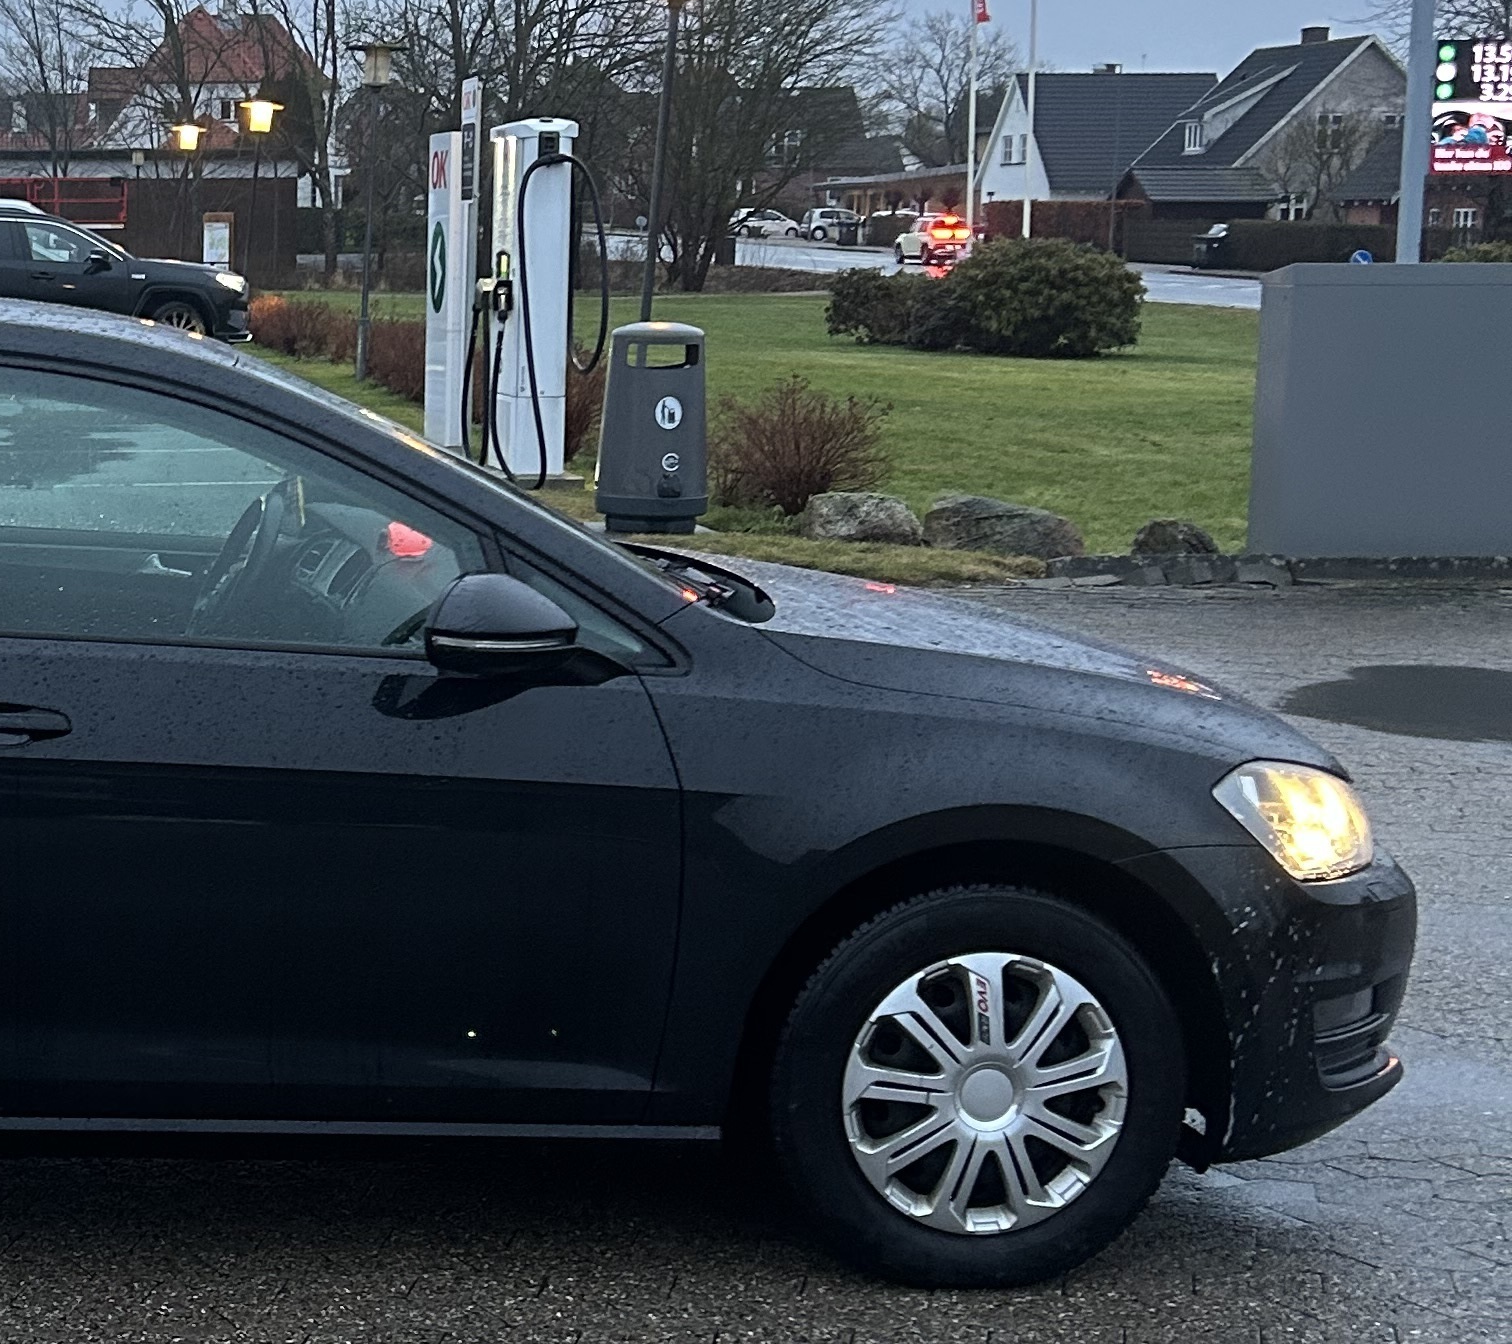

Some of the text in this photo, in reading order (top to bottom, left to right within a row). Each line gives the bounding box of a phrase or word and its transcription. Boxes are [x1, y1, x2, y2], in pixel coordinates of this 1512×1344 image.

[1471, 63, 1512, 83] 13.1
[1479, 83, 1512, 102] 3.2
[431, 149, 449, 190] OK
[975, 977, 989, 1013] EVO
